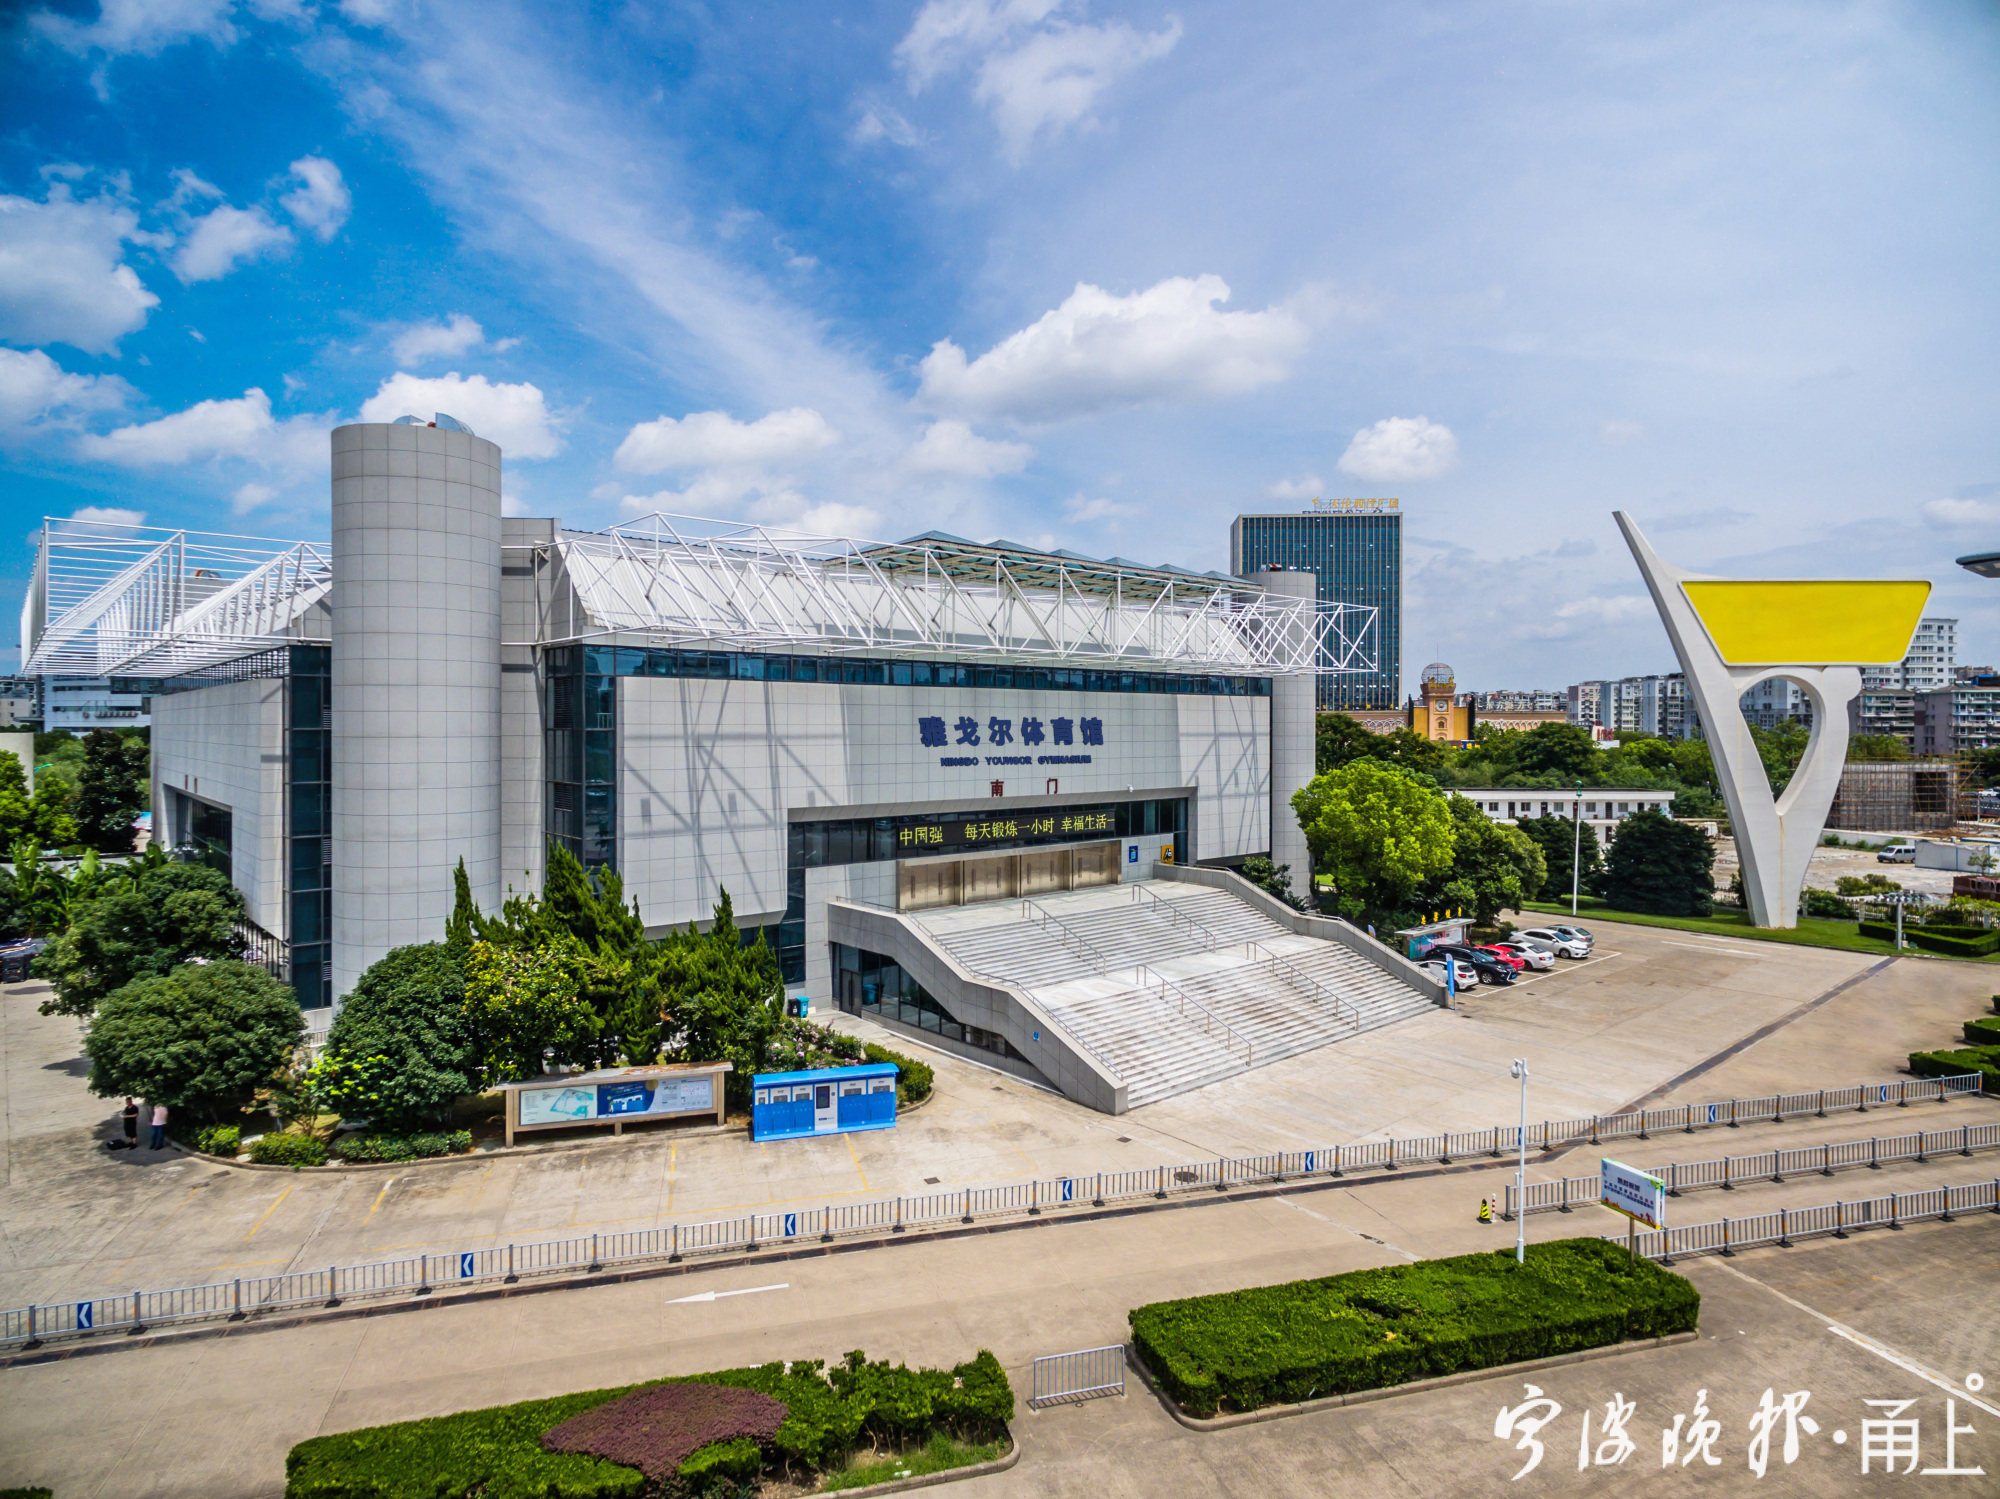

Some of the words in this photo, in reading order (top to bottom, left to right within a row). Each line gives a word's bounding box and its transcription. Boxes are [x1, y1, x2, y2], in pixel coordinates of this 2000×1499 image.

[919, 716, 1104, 747] 雅戈尔体育馆
[899, 826, 944, 847] 中国强
[964, 817, 1055, 841] 每天锻炼一小时
